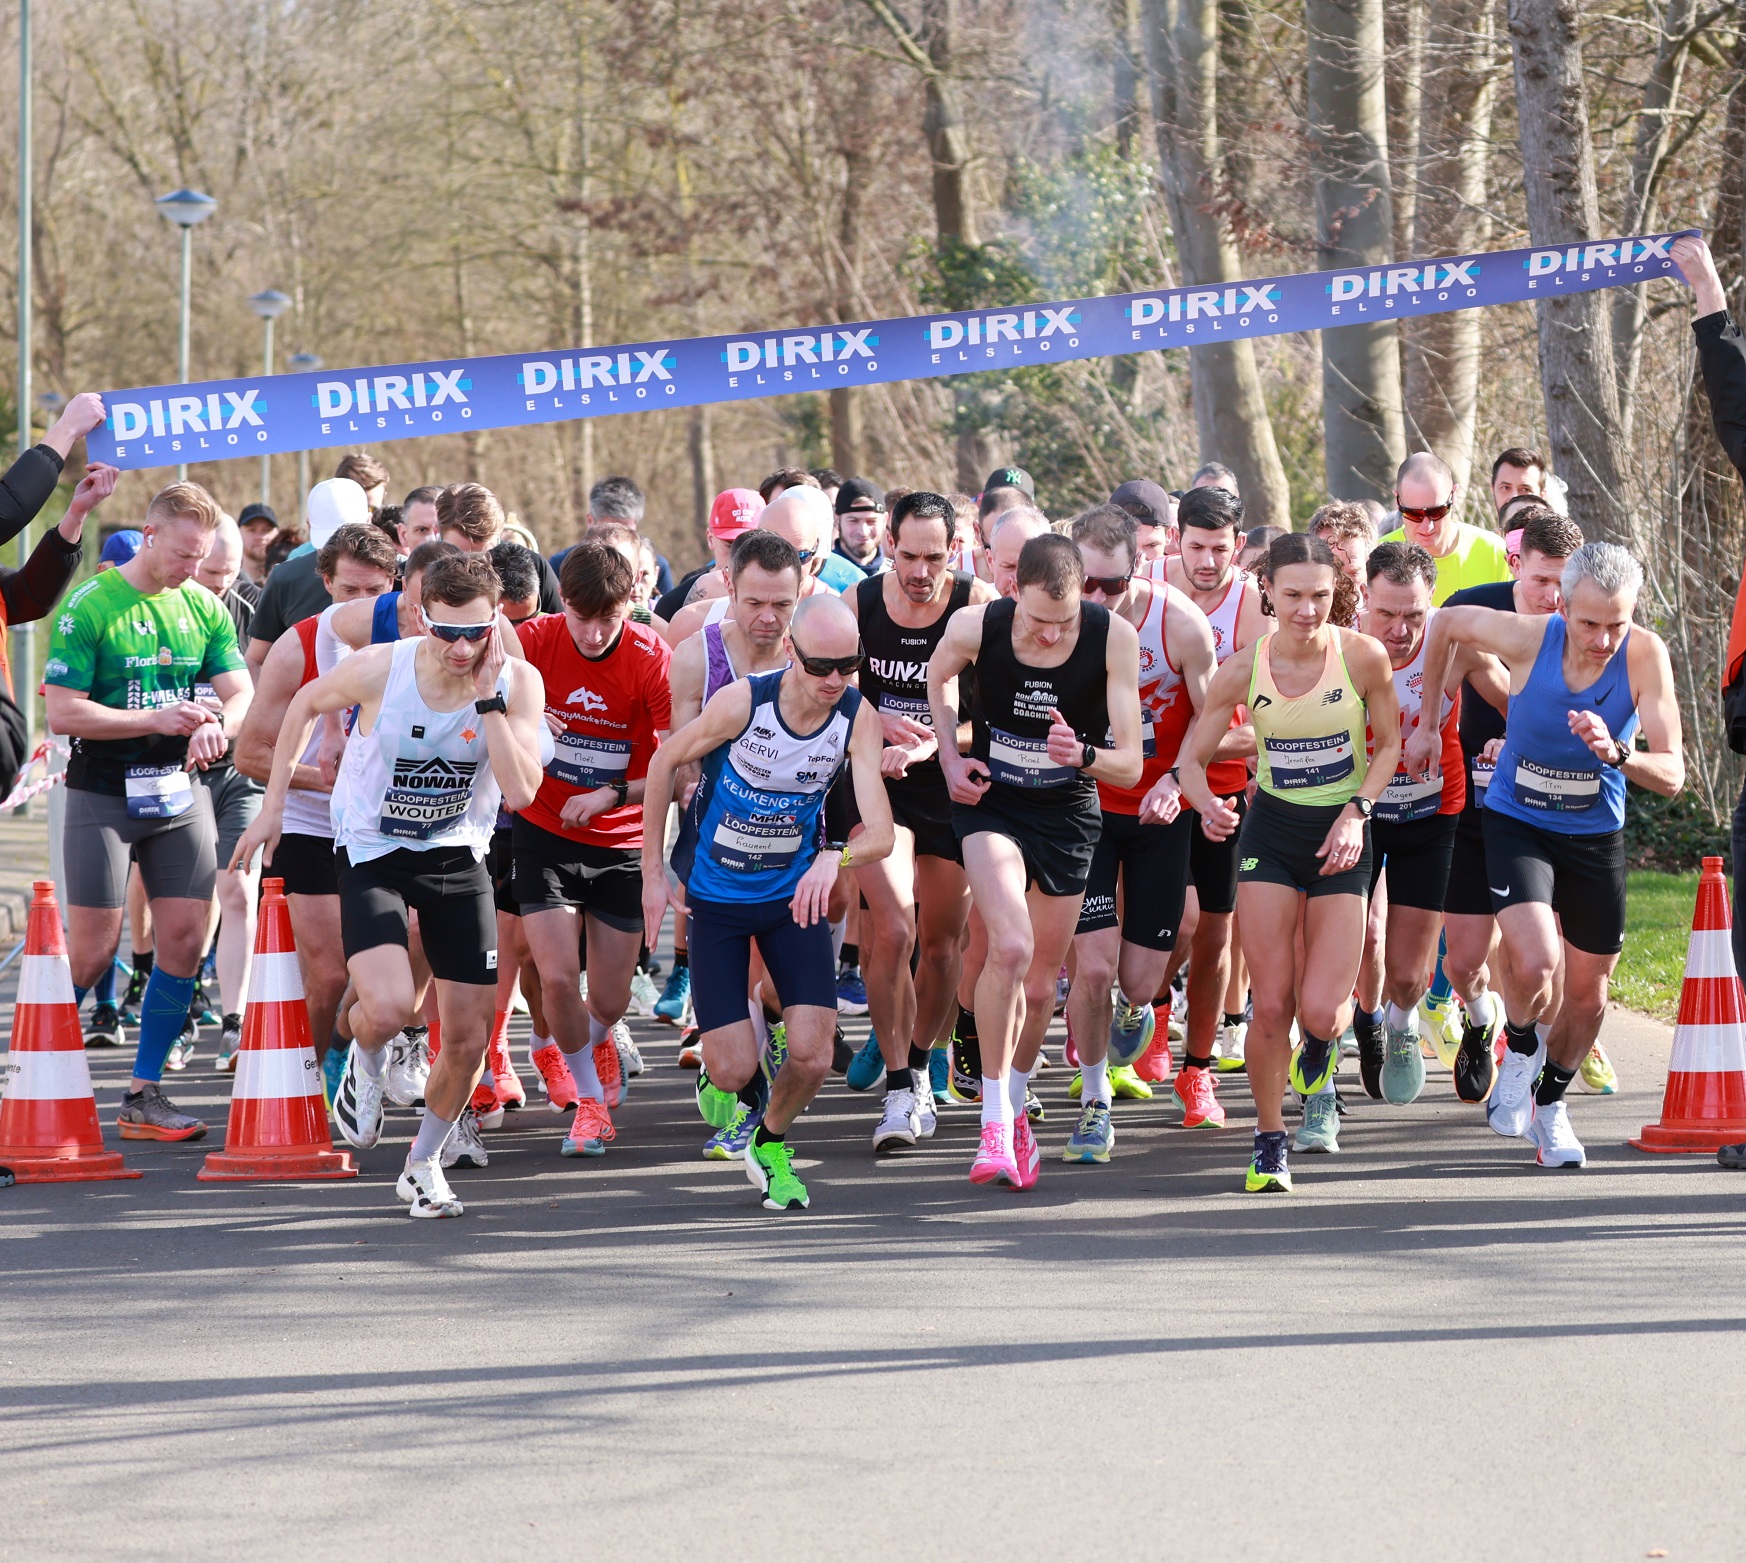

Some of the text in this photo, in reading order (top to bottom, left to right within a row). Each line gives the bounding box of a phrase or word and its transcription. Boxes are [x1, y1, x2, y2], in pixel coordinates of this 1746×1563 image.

[1529, 236, 1672, 277] DIRIX
[1332, 260, 1476, 302] DIRIX
[1529, 260, 1671, 288] ELSLOO
[1131, 283, 1277, 326] DIRIX
[1332, 288, 1477, 315] ELSLOO
[930, 306, 1076, 350] DIRIX
[1132, 313, 1279, 340] ELSLOO
[727, 328, 875, 373] DIRIX
[931, 338, 1079, 364] ELSLOO
[523, 349, 672, 395] DIRIX
[729, 361, 878, 388] ELSLOO
[317, 369, 469, 419] DIRIX
[526, 384, 676, 411] ELSLOO
[112, 389, 265, 441] DIRIX
[321, 407, 472, 434] ELSLOO
[116, 431, 268, 458] ELSLOO
[1024, 681, 1052, 689] FUSION
[740, 738, 779, 760] GERVI
[1270, 736, 1344, 750] LOOPFESTEIN
[392, 774, 473, 789] NOWAK
[580, 767, 594, 775] 109
[1522, 759, 1594, 780] LOOPFESTEIN
[389, 802, 466, 819] WOUTER
[391, 790, 468, 806] LOOPFESTEIN
[724, 817, 799, 836] LOOPFESTEIN
[750, 813, 787, 822] MHK
[392, 828, 418, 837] DIRIX
